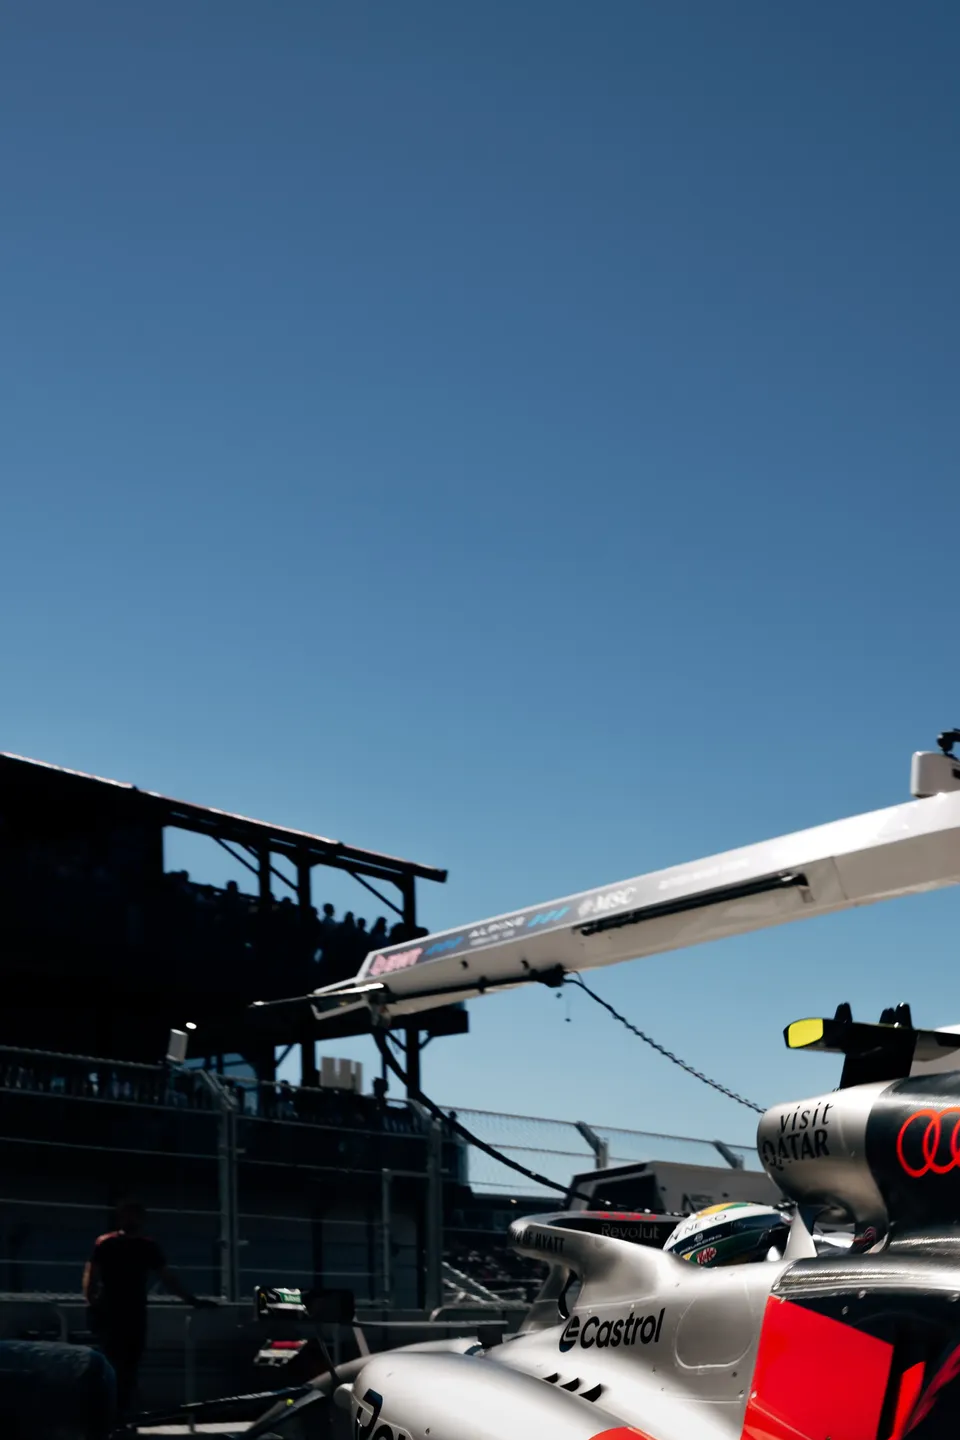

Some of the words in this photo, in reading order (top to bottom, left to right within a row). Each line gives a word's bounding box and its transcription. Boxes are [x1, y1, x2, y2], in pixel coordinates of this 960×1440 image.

[780, 1102, 834, 1133] visit
[762, 1129, 830, 1166] QATAR
[535, 1232, 565, 1252] HYATT
[601, 1223, 660, 1240] Revolut
[580, 1307, 666, 1349] Castrol
